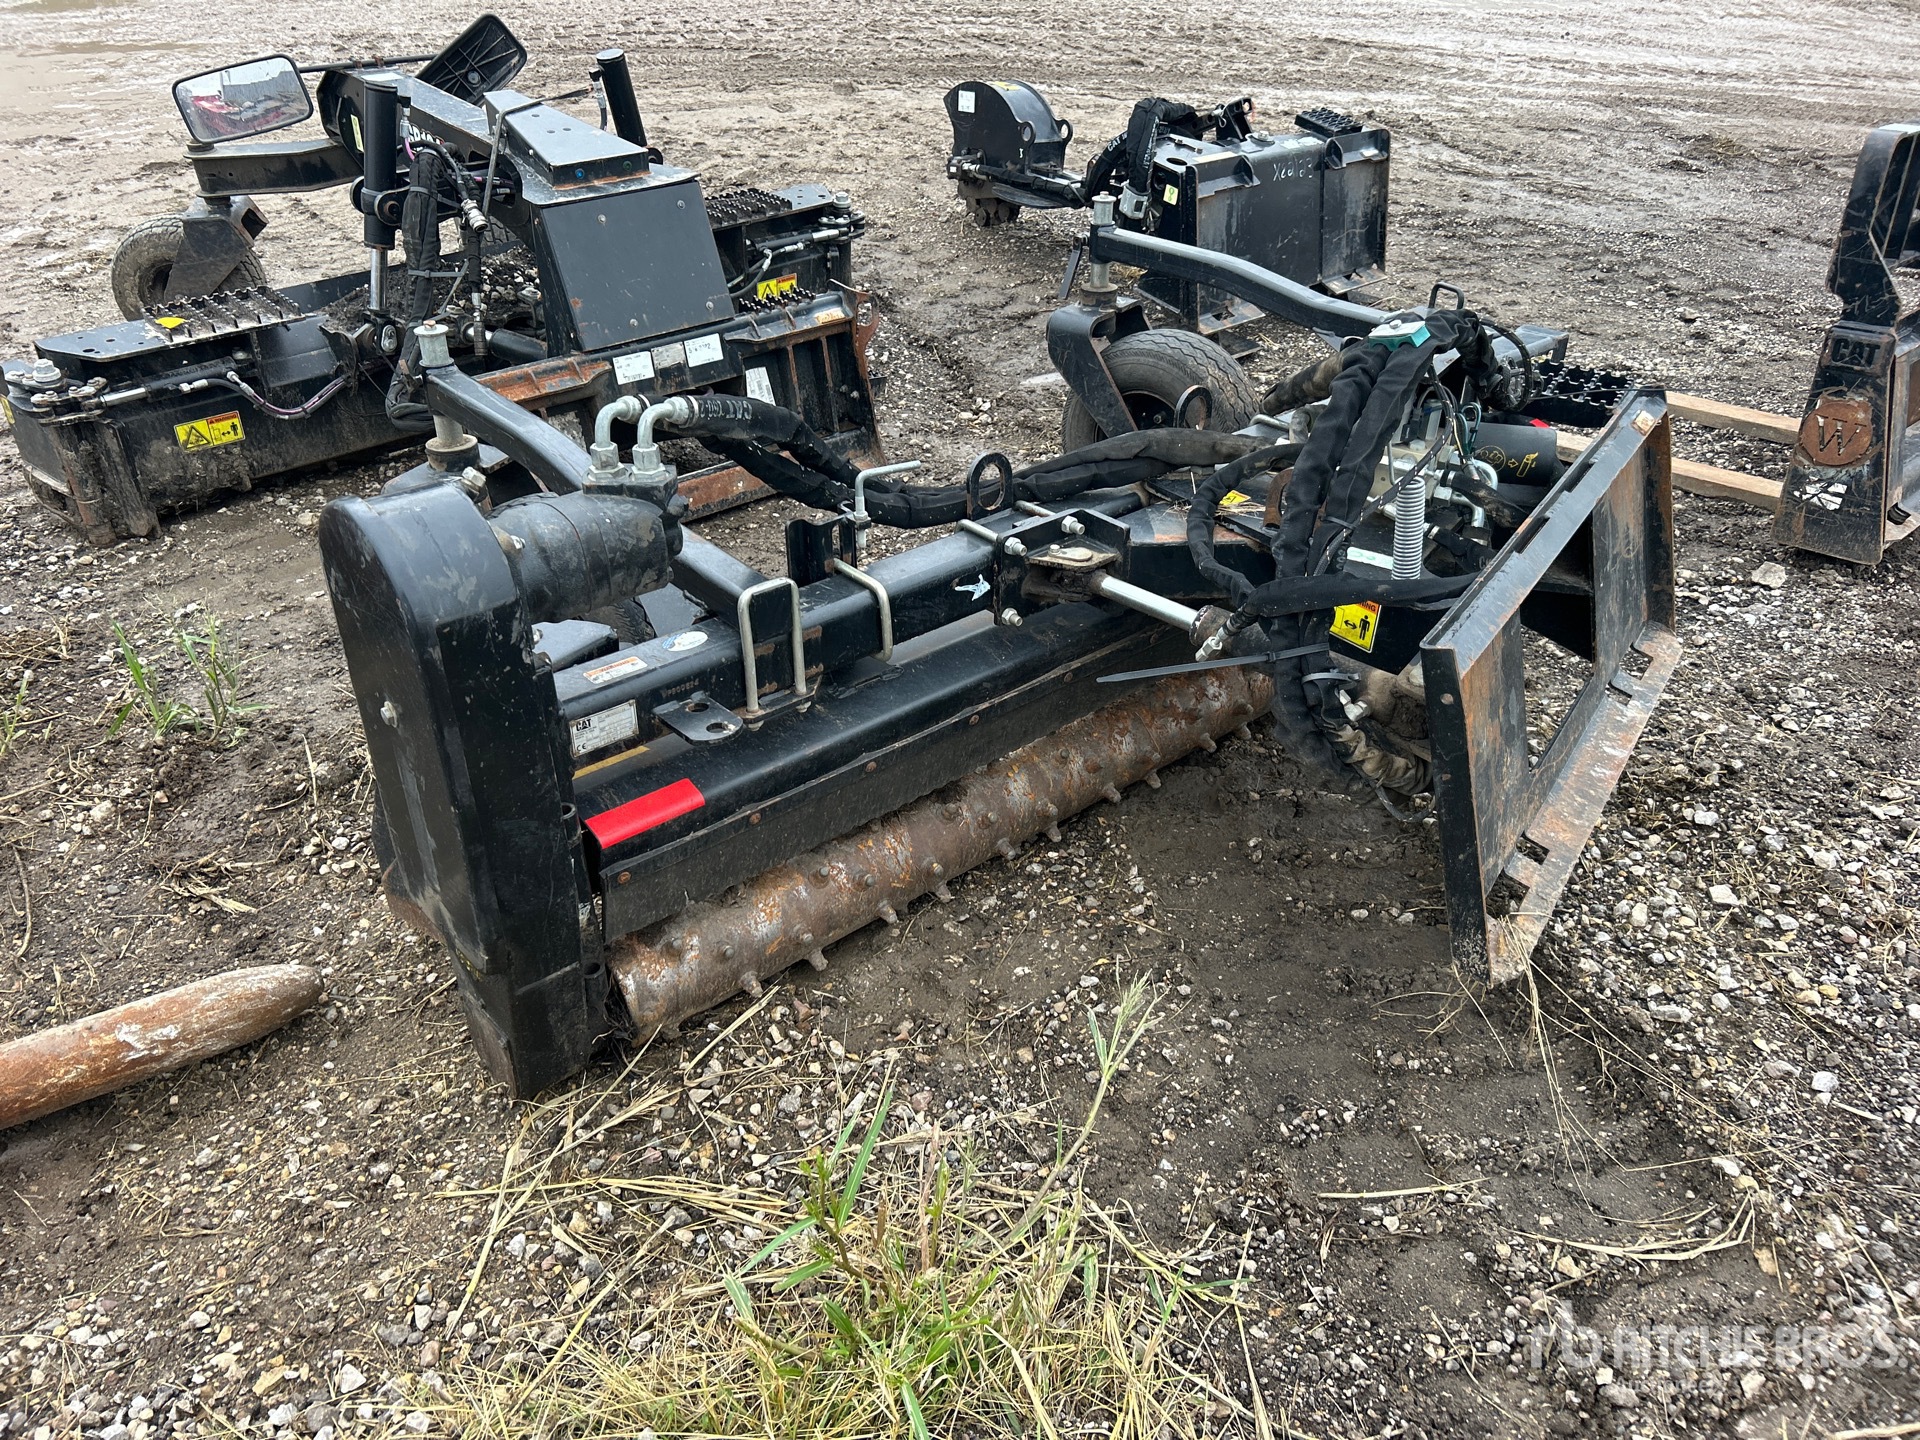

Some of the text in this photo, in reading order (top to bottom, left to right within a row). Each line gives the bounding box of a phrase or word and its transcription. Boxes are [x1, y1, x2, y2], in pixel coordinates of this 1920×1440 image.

[1831, 339, 1881, 367] CAT
[725, 400, 753, 420] CAT
[1815, 413, 1867, 456] W
[575, 718, 592, 732] CAT
